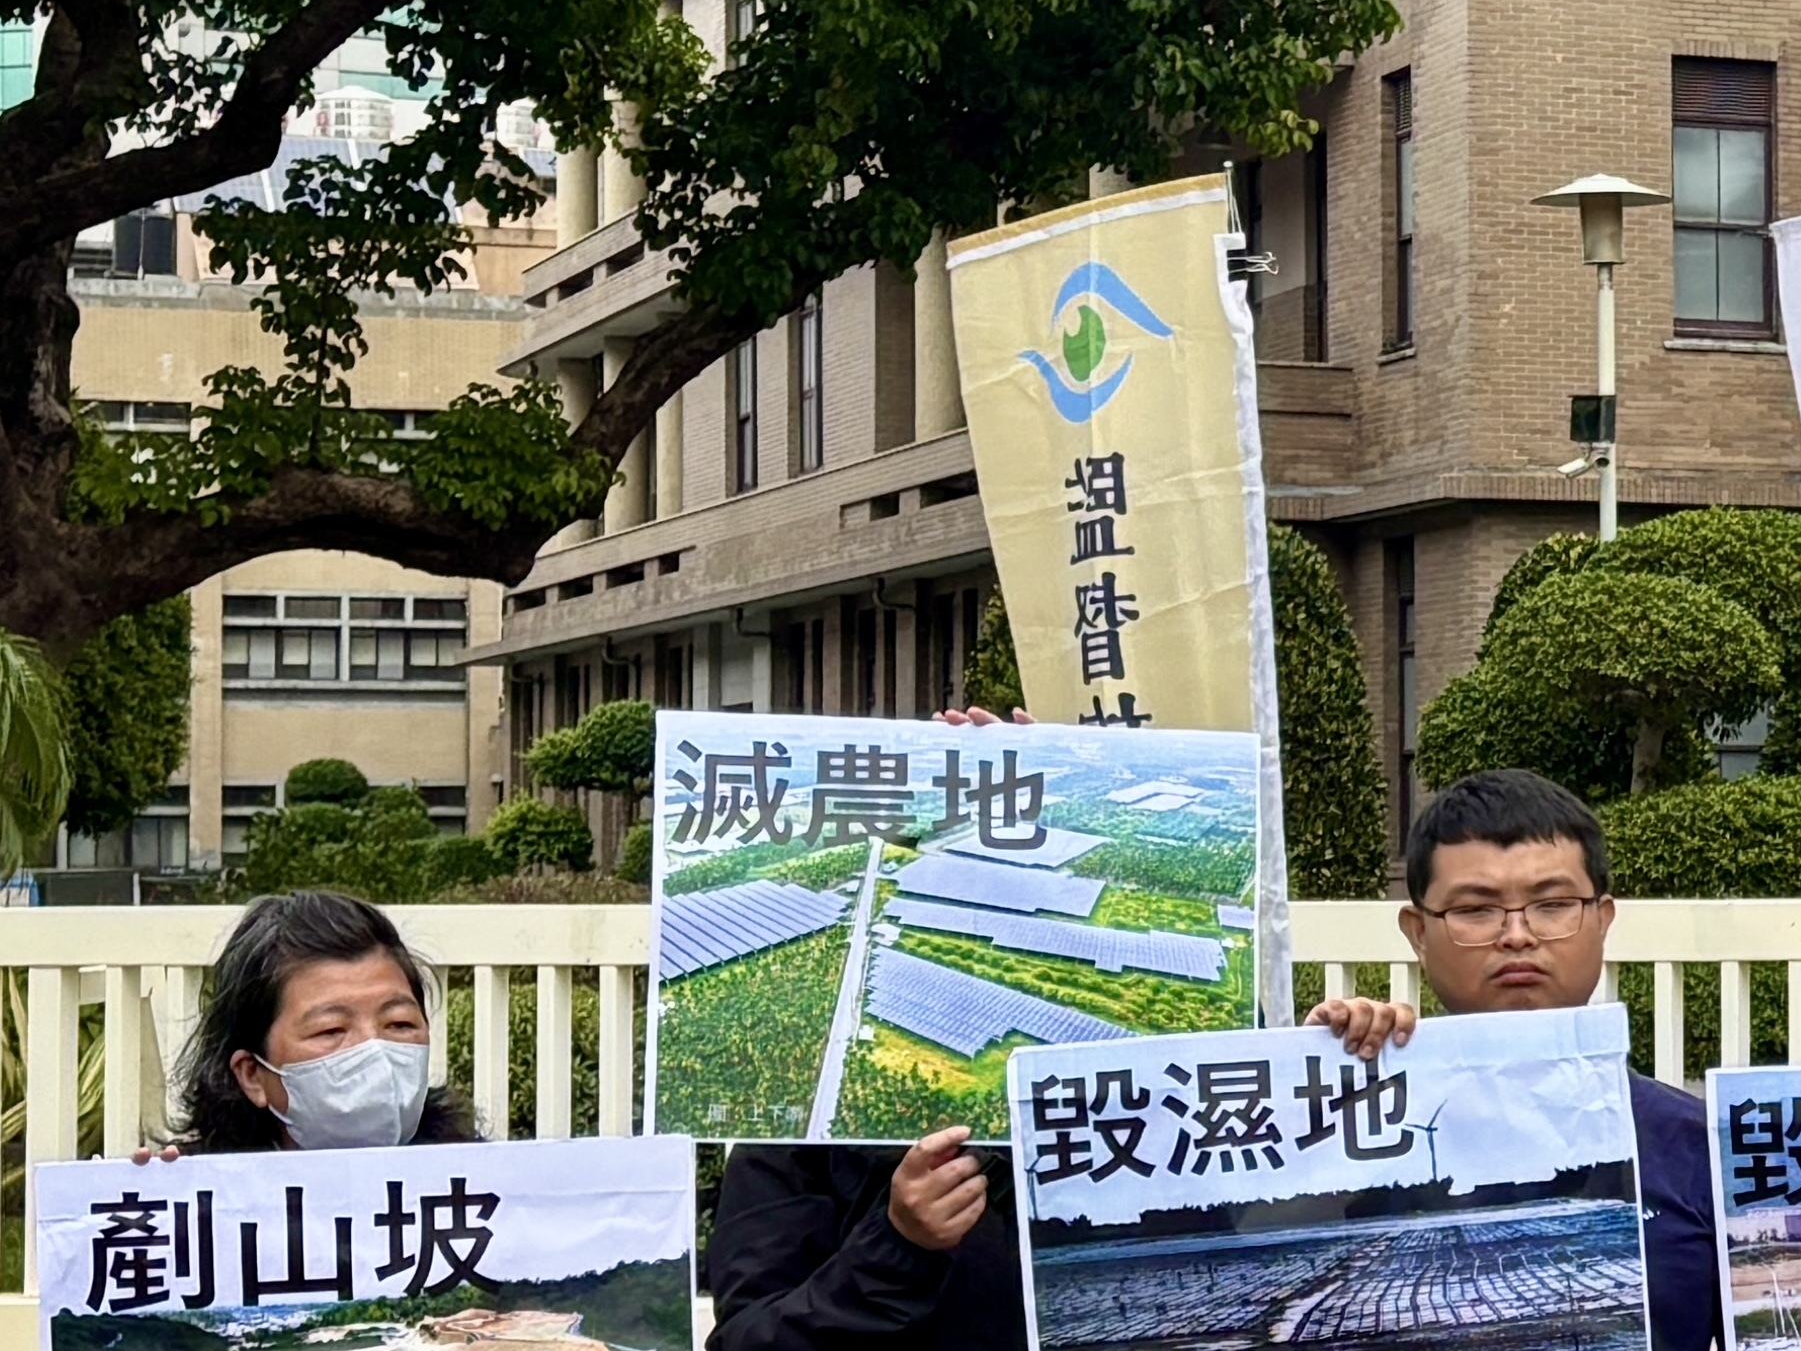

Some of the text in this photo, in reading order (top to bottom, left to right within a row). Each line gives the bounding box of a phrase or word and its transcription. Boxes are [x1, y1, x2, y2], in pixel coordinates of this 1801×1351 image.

[671, 740, 1045, 851] 滅農地
[1030, 1054, 1416, 1186] 毀濕地
[86, 1177, 502, 1313] 剷山坡
